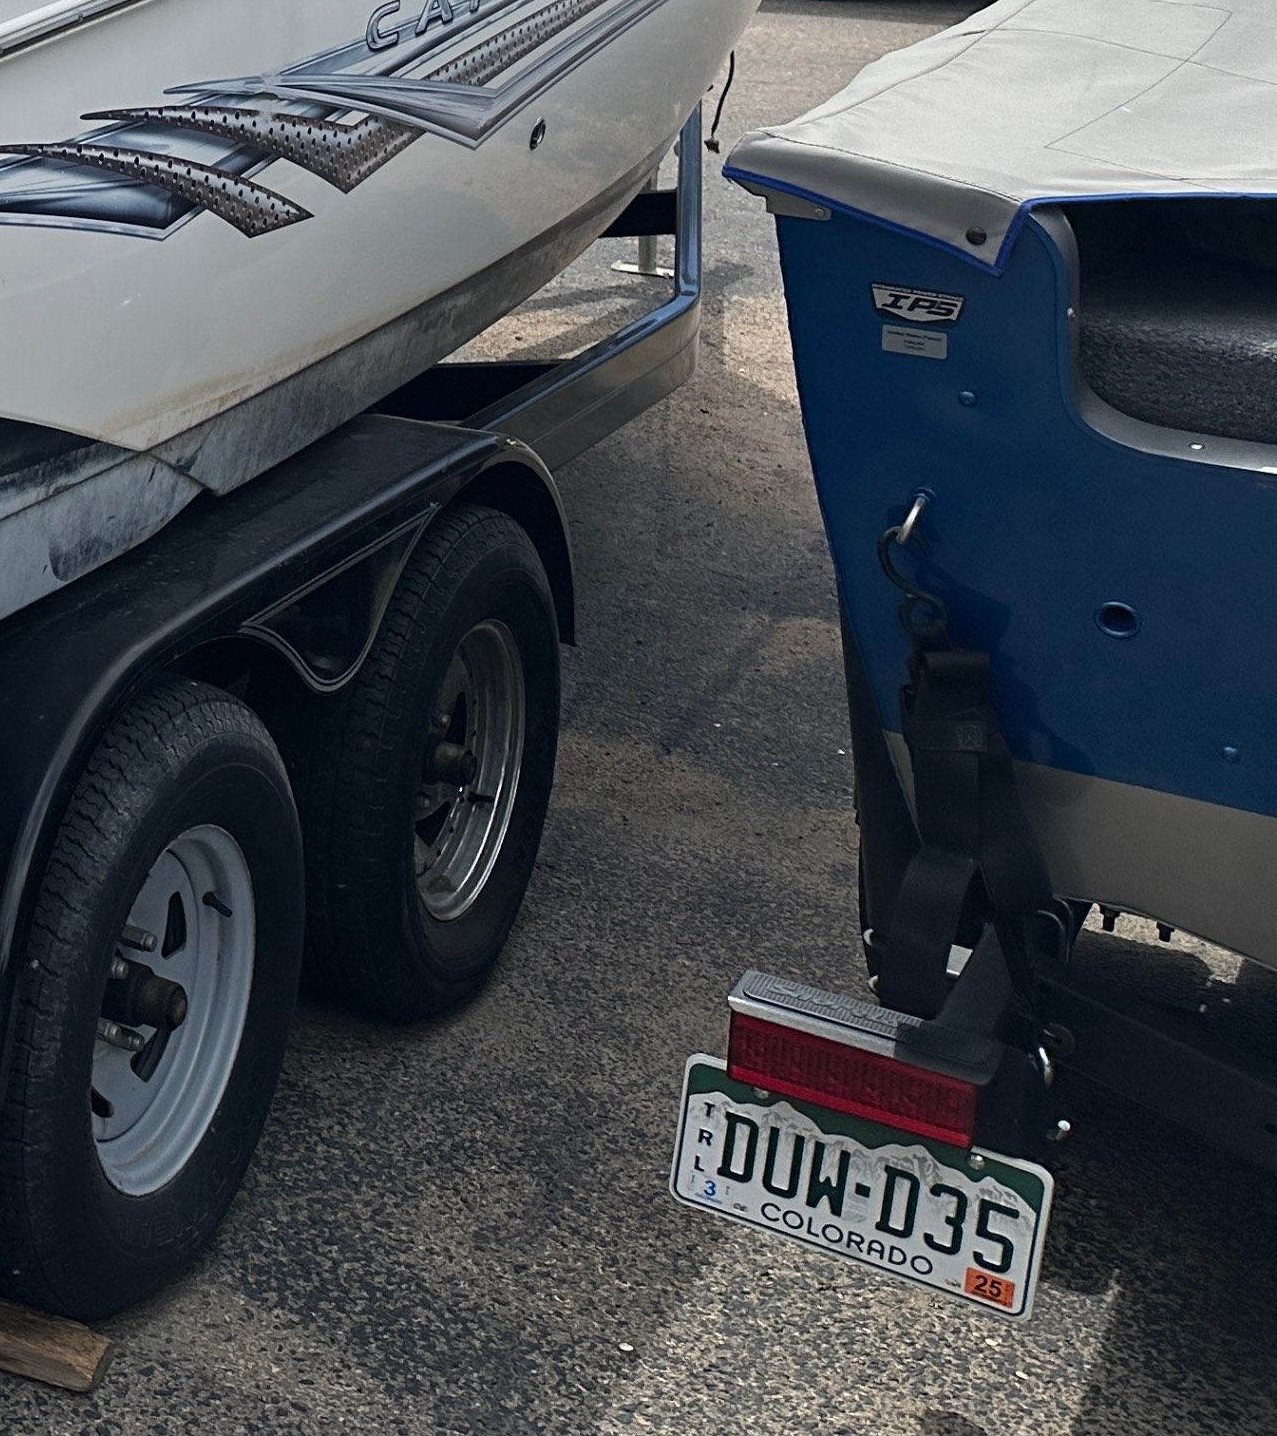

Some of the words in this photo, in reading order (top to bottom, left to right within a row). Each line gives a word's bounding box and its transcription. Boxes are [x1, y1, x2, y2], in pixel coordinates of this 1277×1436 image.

[881, 293, 959, 316] IPS
[703, 1180, 716, 1197] 3
[717, 1111, 1020, 1274] DUW-D35
[760, 1202, 934, 1275] COLORADO
[972, 1274, 1002, 1298] 25
